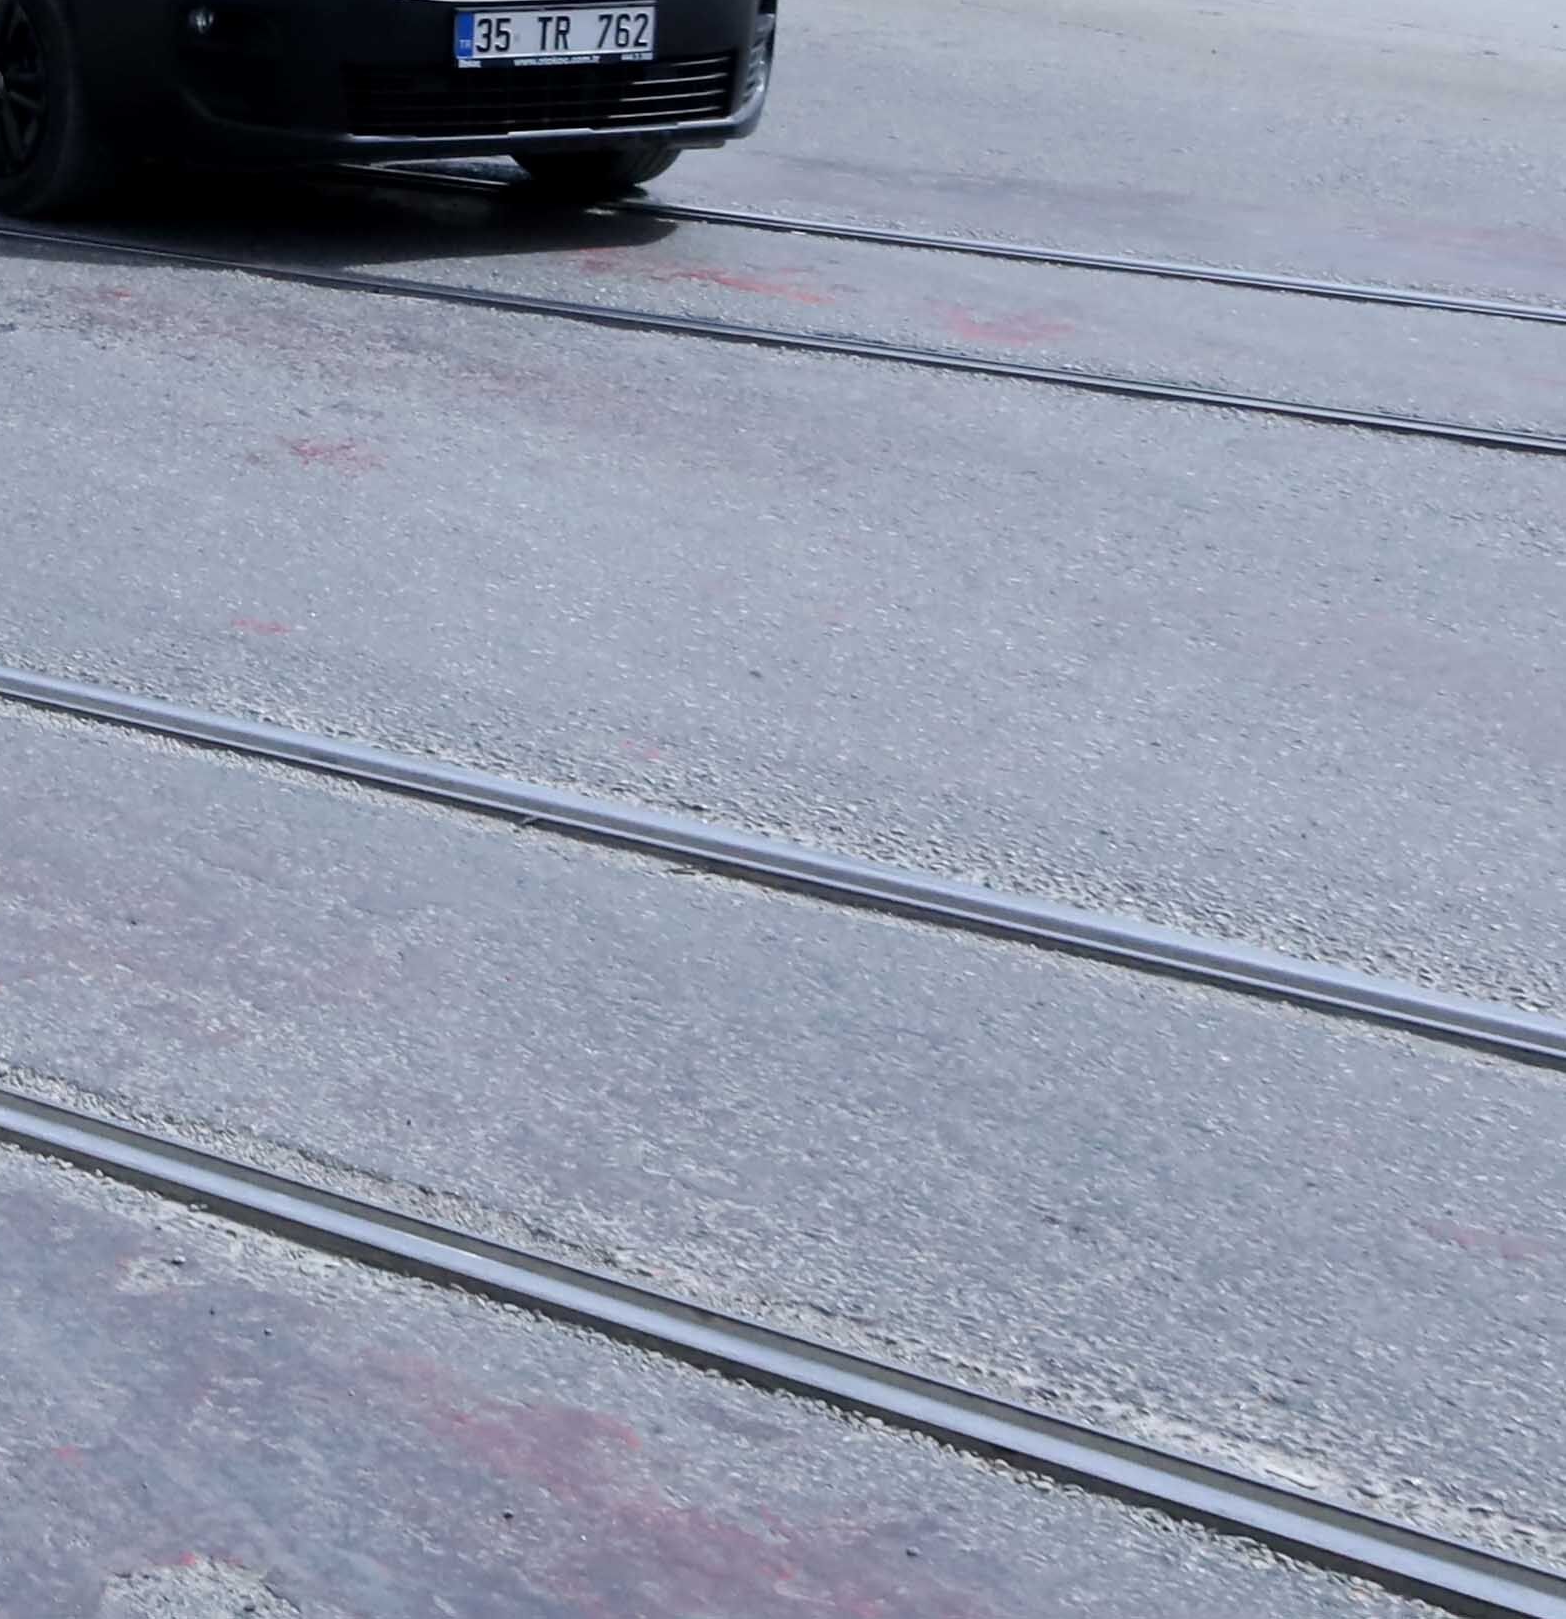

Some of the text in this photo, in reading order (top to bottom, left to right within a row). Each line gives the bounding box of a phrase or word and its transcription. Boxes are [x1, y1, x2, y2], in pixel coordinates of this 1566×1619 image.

[476, 13, 649, 53] 35 TR 762
